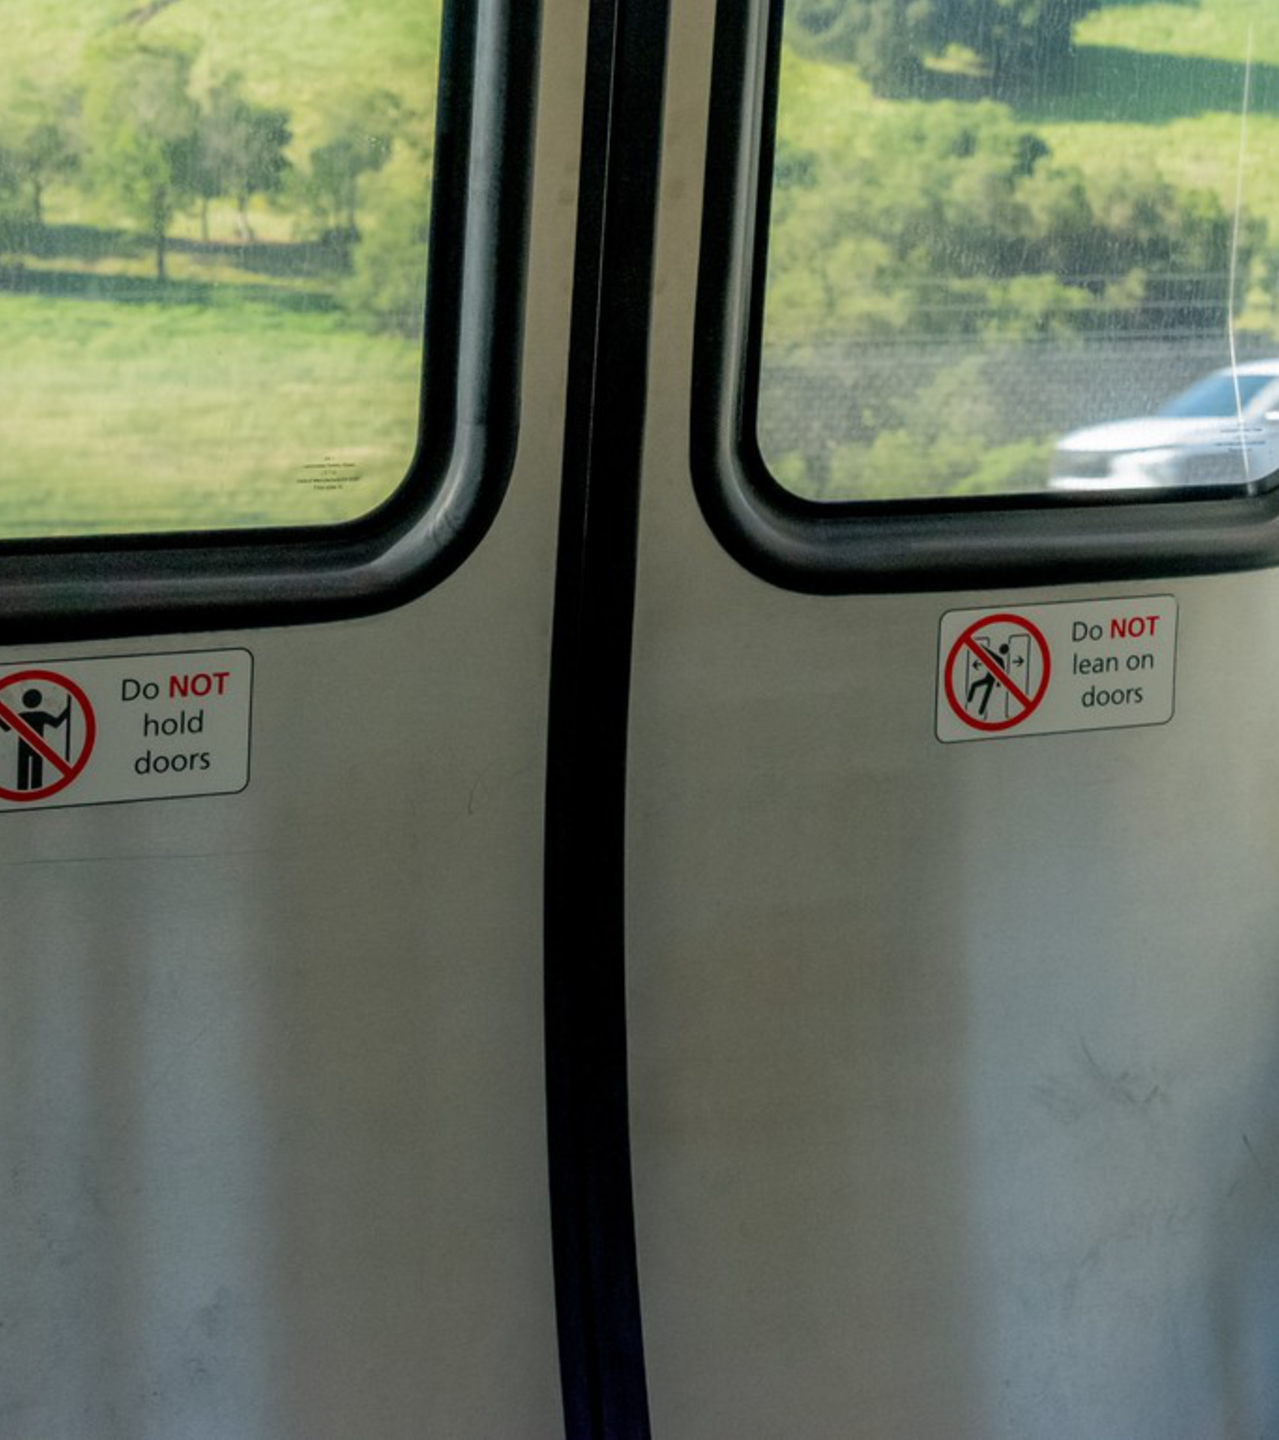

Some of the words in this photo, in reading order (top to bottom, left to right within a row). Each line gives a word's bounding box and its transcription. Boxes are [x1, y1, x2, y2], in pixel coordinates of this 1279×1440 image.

[1071, 620, 1103, 642] Do
[1109, 615, 1161, 640] NOT
[1072, 653, 1118, 675] lean
[1126, 652, 1155, 671] on
[121, 678, 159, 702] Do
[168, 671, 230, 698] NOT
[1081, 686, 1144, 708] doors
[142, 709, 204, 737] hold
[134, 749, 211, 776] doors
